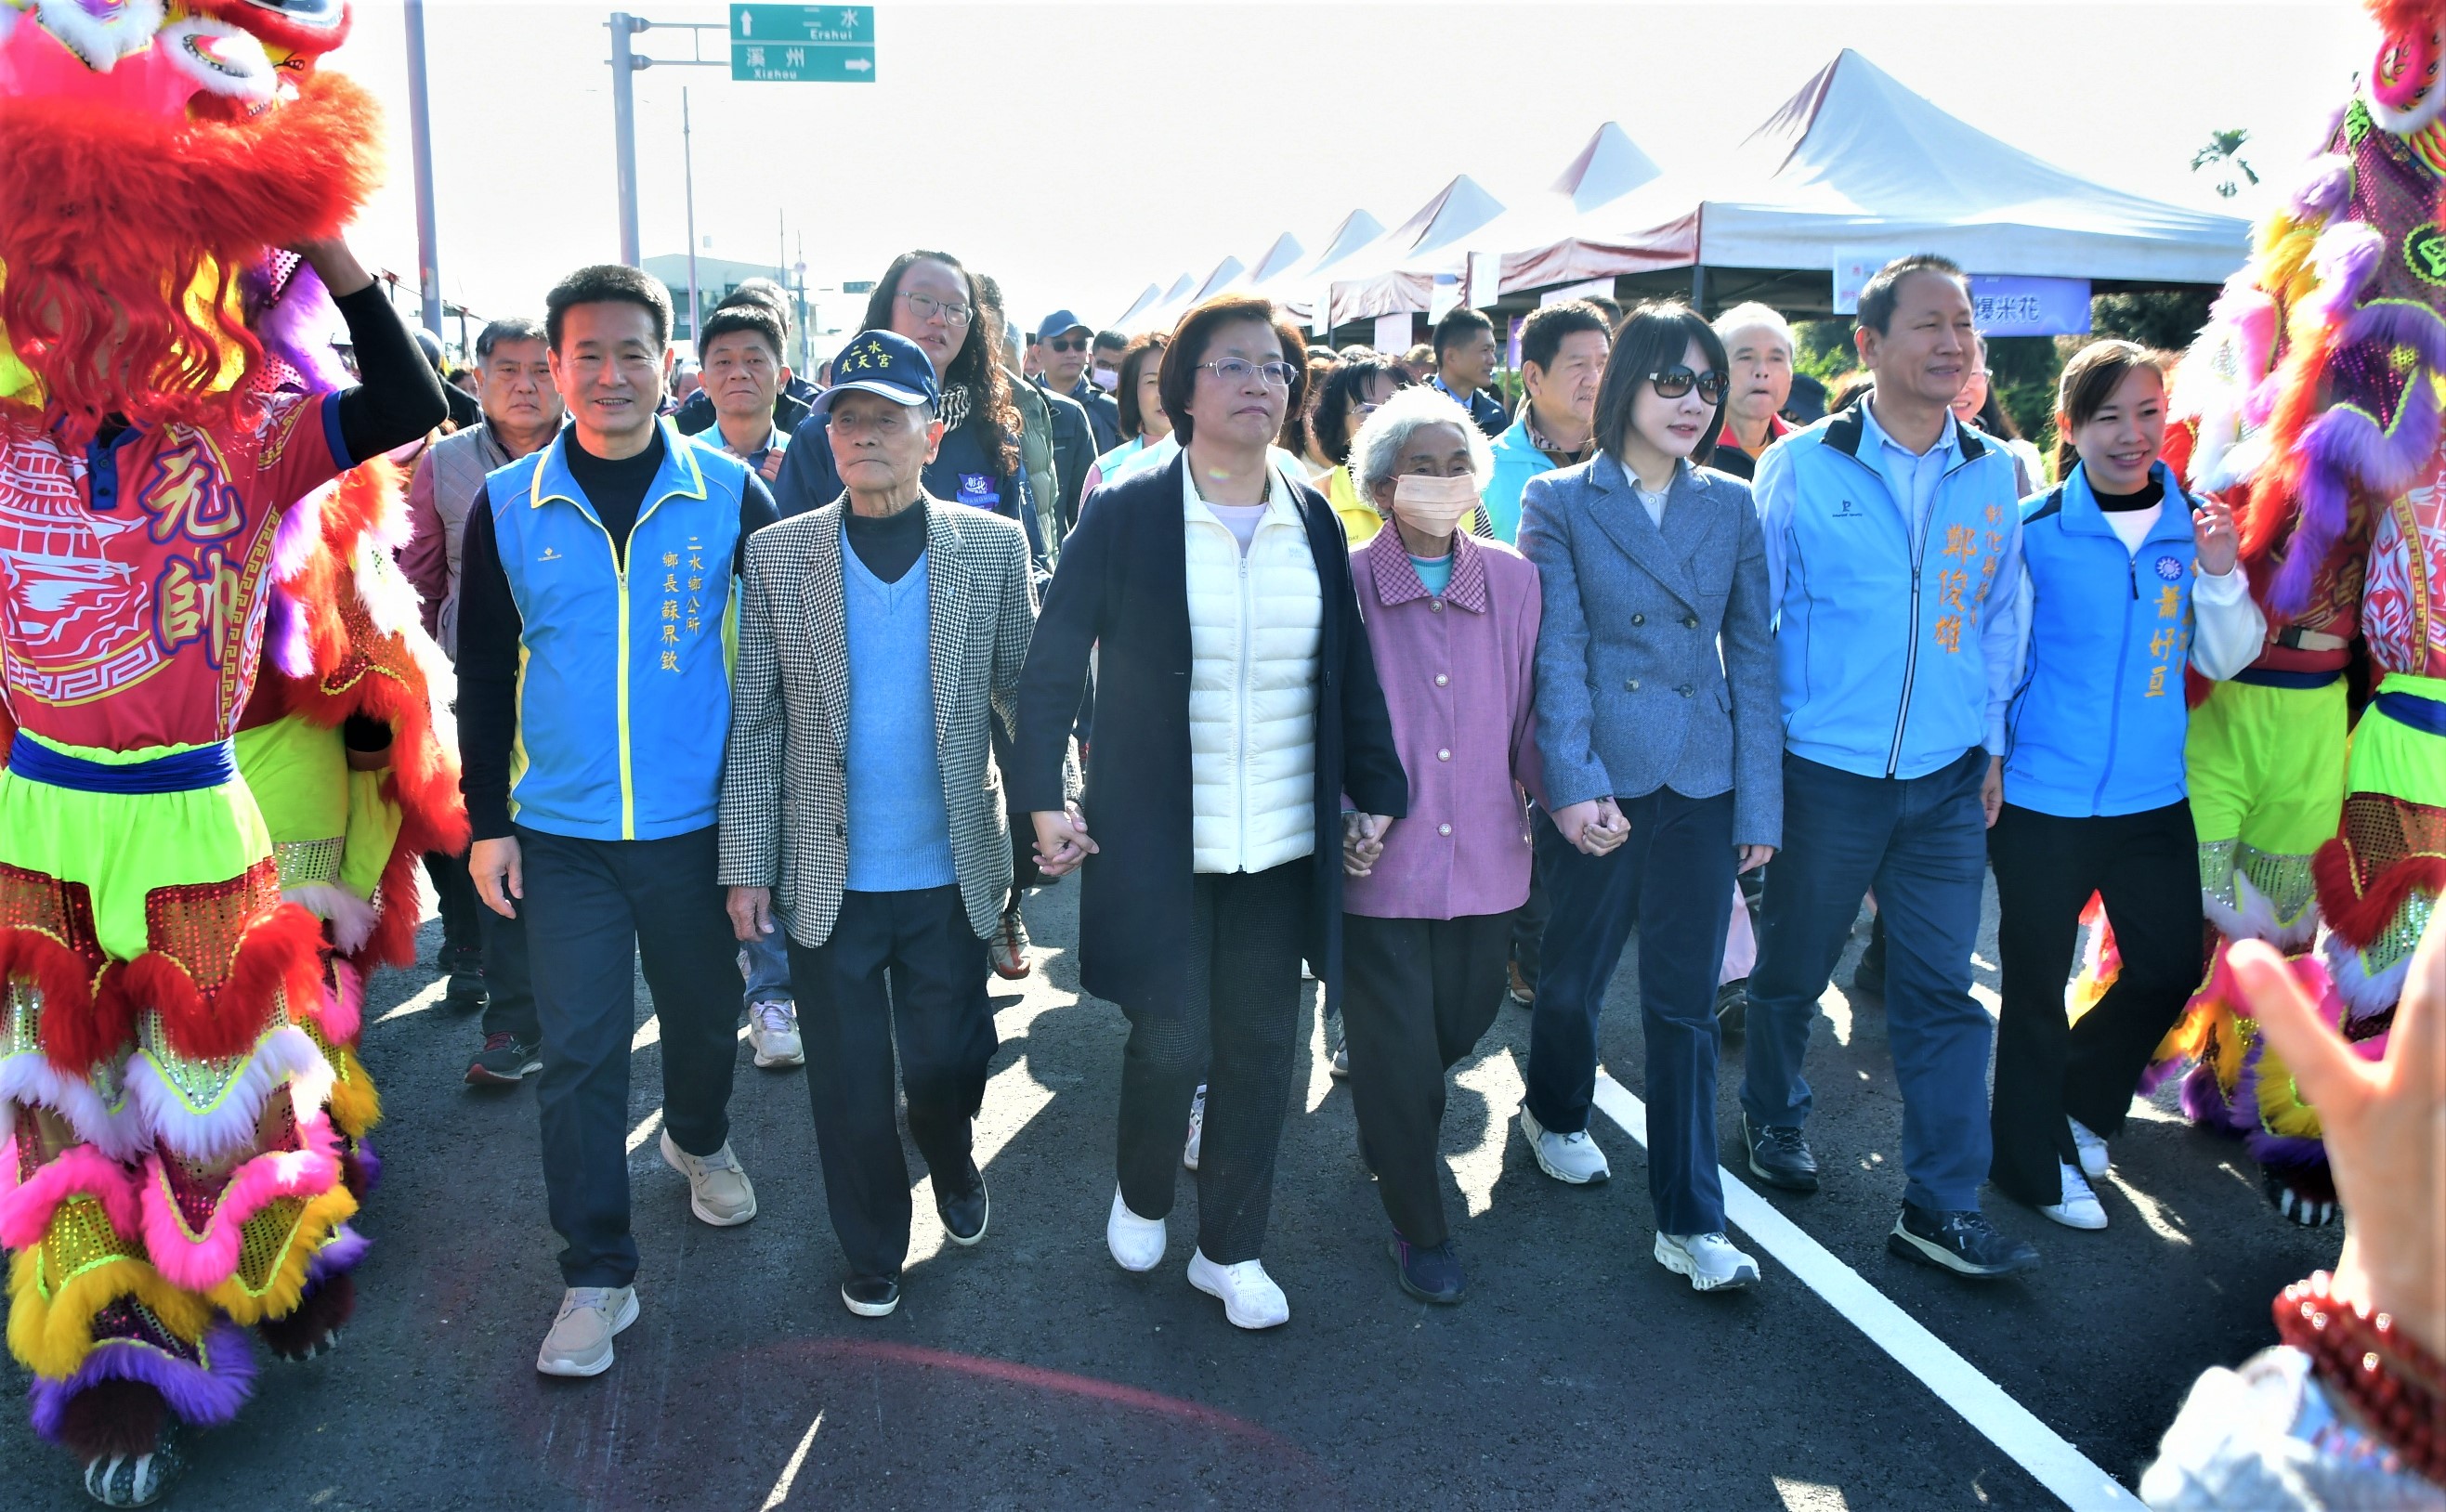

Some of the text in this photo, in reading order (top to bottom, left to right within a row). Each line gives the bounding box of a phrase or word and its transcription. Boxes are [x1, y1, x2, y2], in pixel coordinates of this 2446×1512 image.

[803, 7, 859, 28] 二水
[810, 29, 852, 41] Ershui
[747, 46, 804, 68] 溪州
[754, 69, 797, 80] Xizhou
[1973, 295, 2040, 322] 爆米花
[851, 340, 883, 357] 二水
[146, 447, 240, 662] 元帥
[686, 536, 704, 635] 二水鄉公所
[1934, 523, 1977, 654] 鄭俊雄
[661, 551, 681, 673] 鄉長蘇界欽
